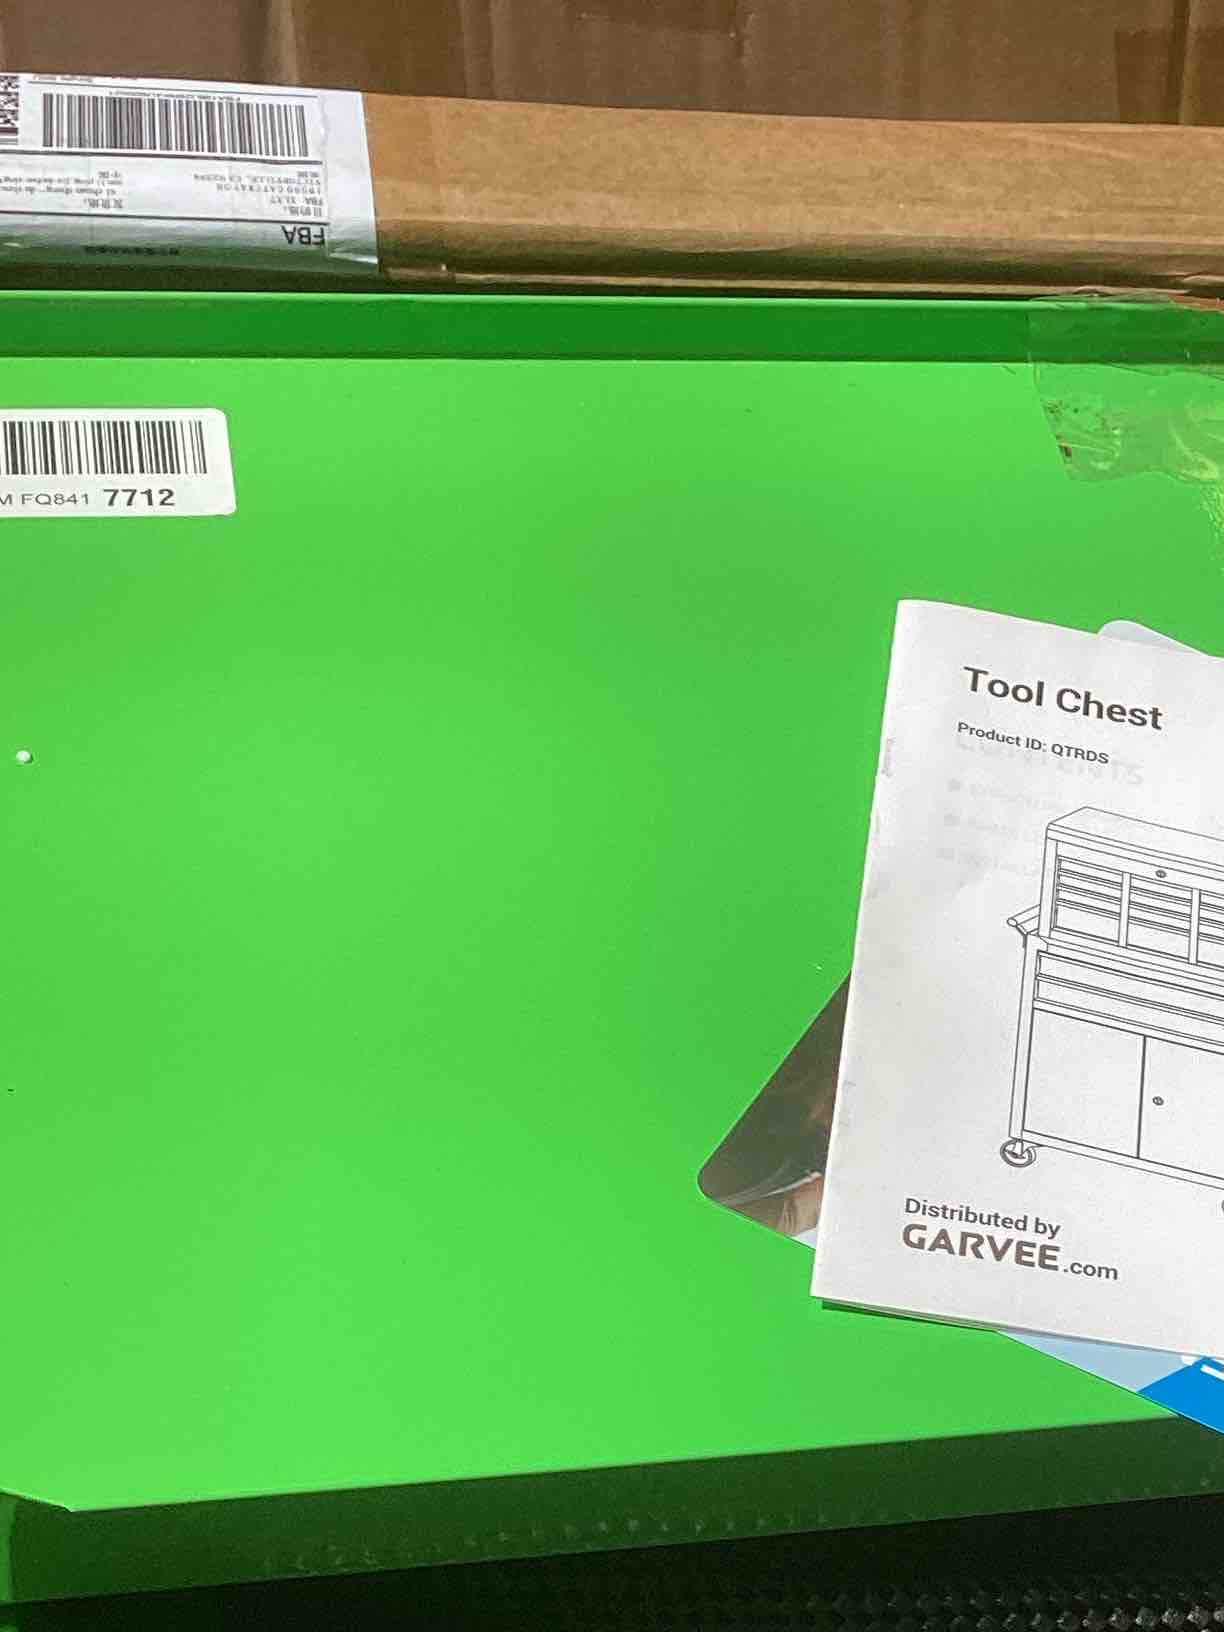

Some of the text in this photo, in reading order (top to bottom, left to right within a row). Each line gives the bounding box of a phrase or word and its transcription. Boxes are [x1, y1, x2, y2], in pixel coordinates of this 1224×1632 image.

[281, 225, 326, 246] FBA
[21, 493, 90, 506] FQ841
[103, 488, 176, 507] 7712
[963, 666, 1163, 730] Tool Chest
[957, 721, 1110, 764] Product ID: QTRDS
[904, 1197, 1061, 1240] Distributed by
